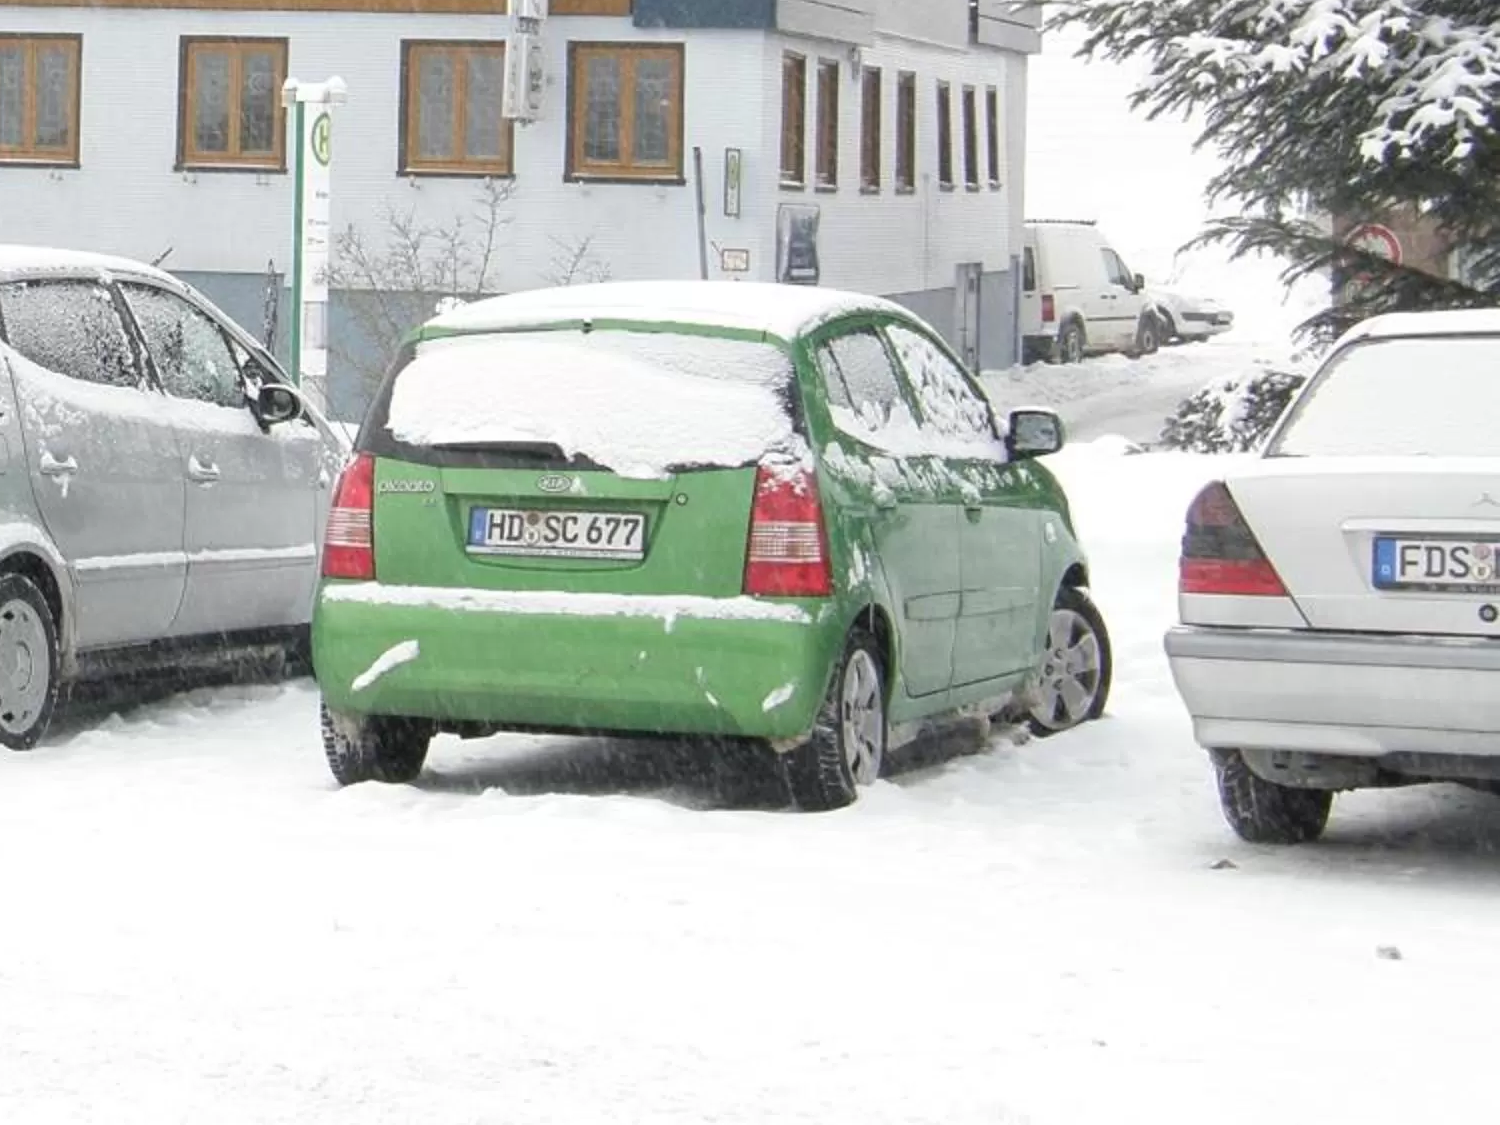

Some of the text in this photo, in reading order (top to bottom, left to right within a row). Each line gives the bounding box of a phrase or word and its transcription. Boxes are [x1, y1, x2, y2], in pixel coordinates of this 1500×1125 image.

[487, 513, 640, 546] HD SC 677
[1399, 544, 1470, 578] FDS
